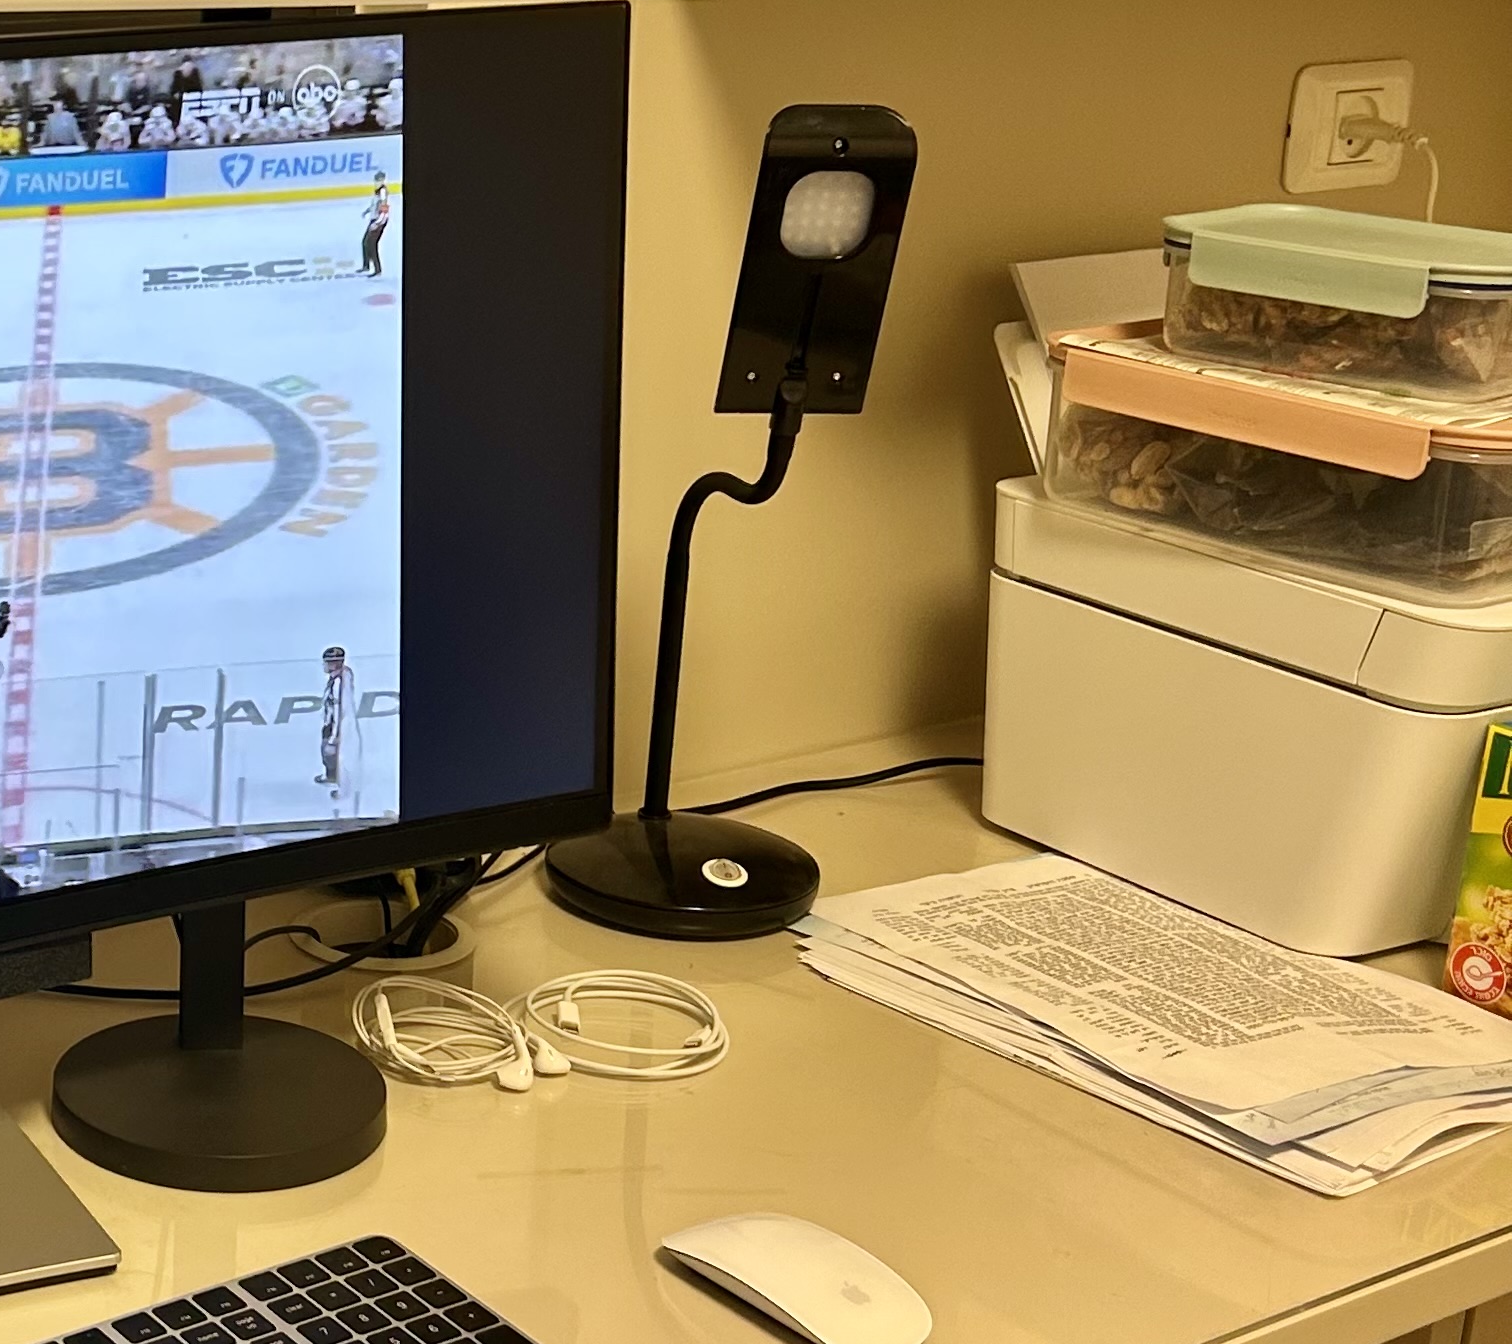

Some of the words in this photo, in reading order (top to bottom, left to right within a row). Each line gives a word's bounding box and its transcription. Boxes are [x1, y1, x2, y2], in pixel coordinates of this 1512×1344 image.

[267, 90, 285, 105] ON
[260, 151, 379, 180] FANDUEL
[15, 167, 129, 195] FANDUEL
[143, 259, 308, 286] ESC
[152, 690, 399, 734] RAPD
